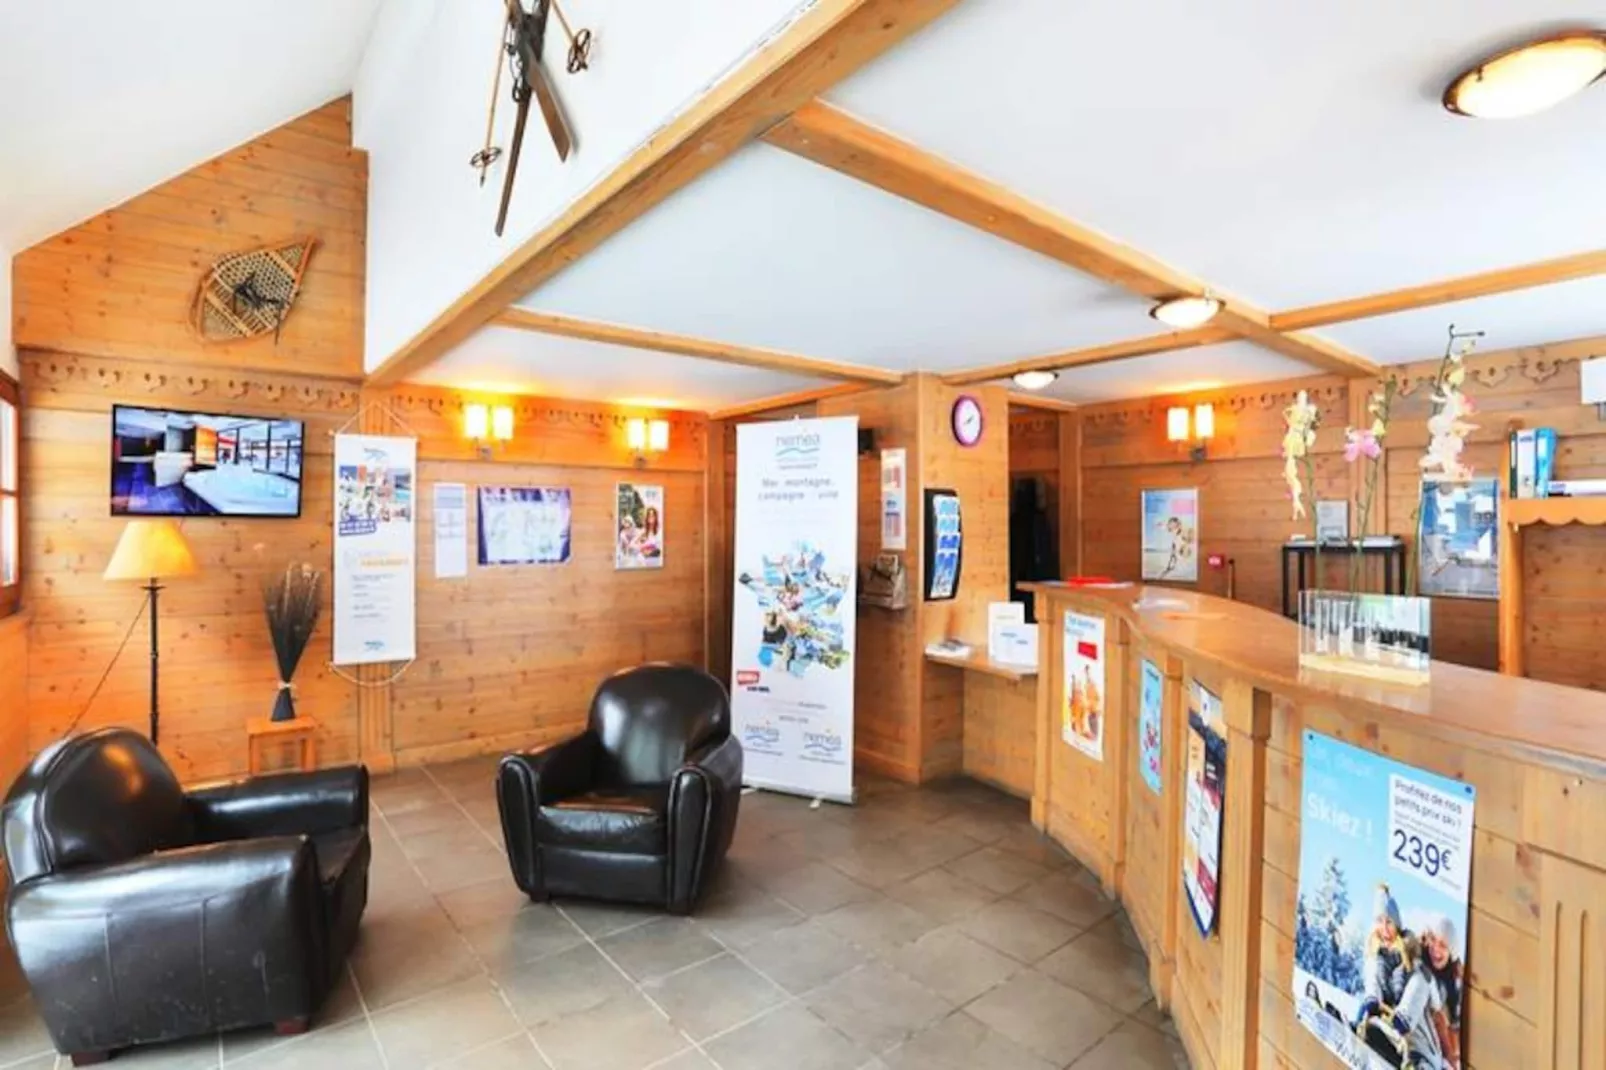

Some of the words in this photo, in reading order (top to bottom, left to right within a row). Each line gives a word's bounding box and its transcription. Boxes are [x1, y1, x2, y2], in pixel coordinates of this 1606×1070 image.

[1307, 791, 1362, 838] Skiez
[1395, 779, 1429, 800] Profitez
[1431, 793, 1443, 805] de
[1445, 799, 1462, 815] nos
[1422, 806, 1439, 820] prix
[1442, 814, 1456, 827] ski
[1393, 828, 1452, 877] 239€
